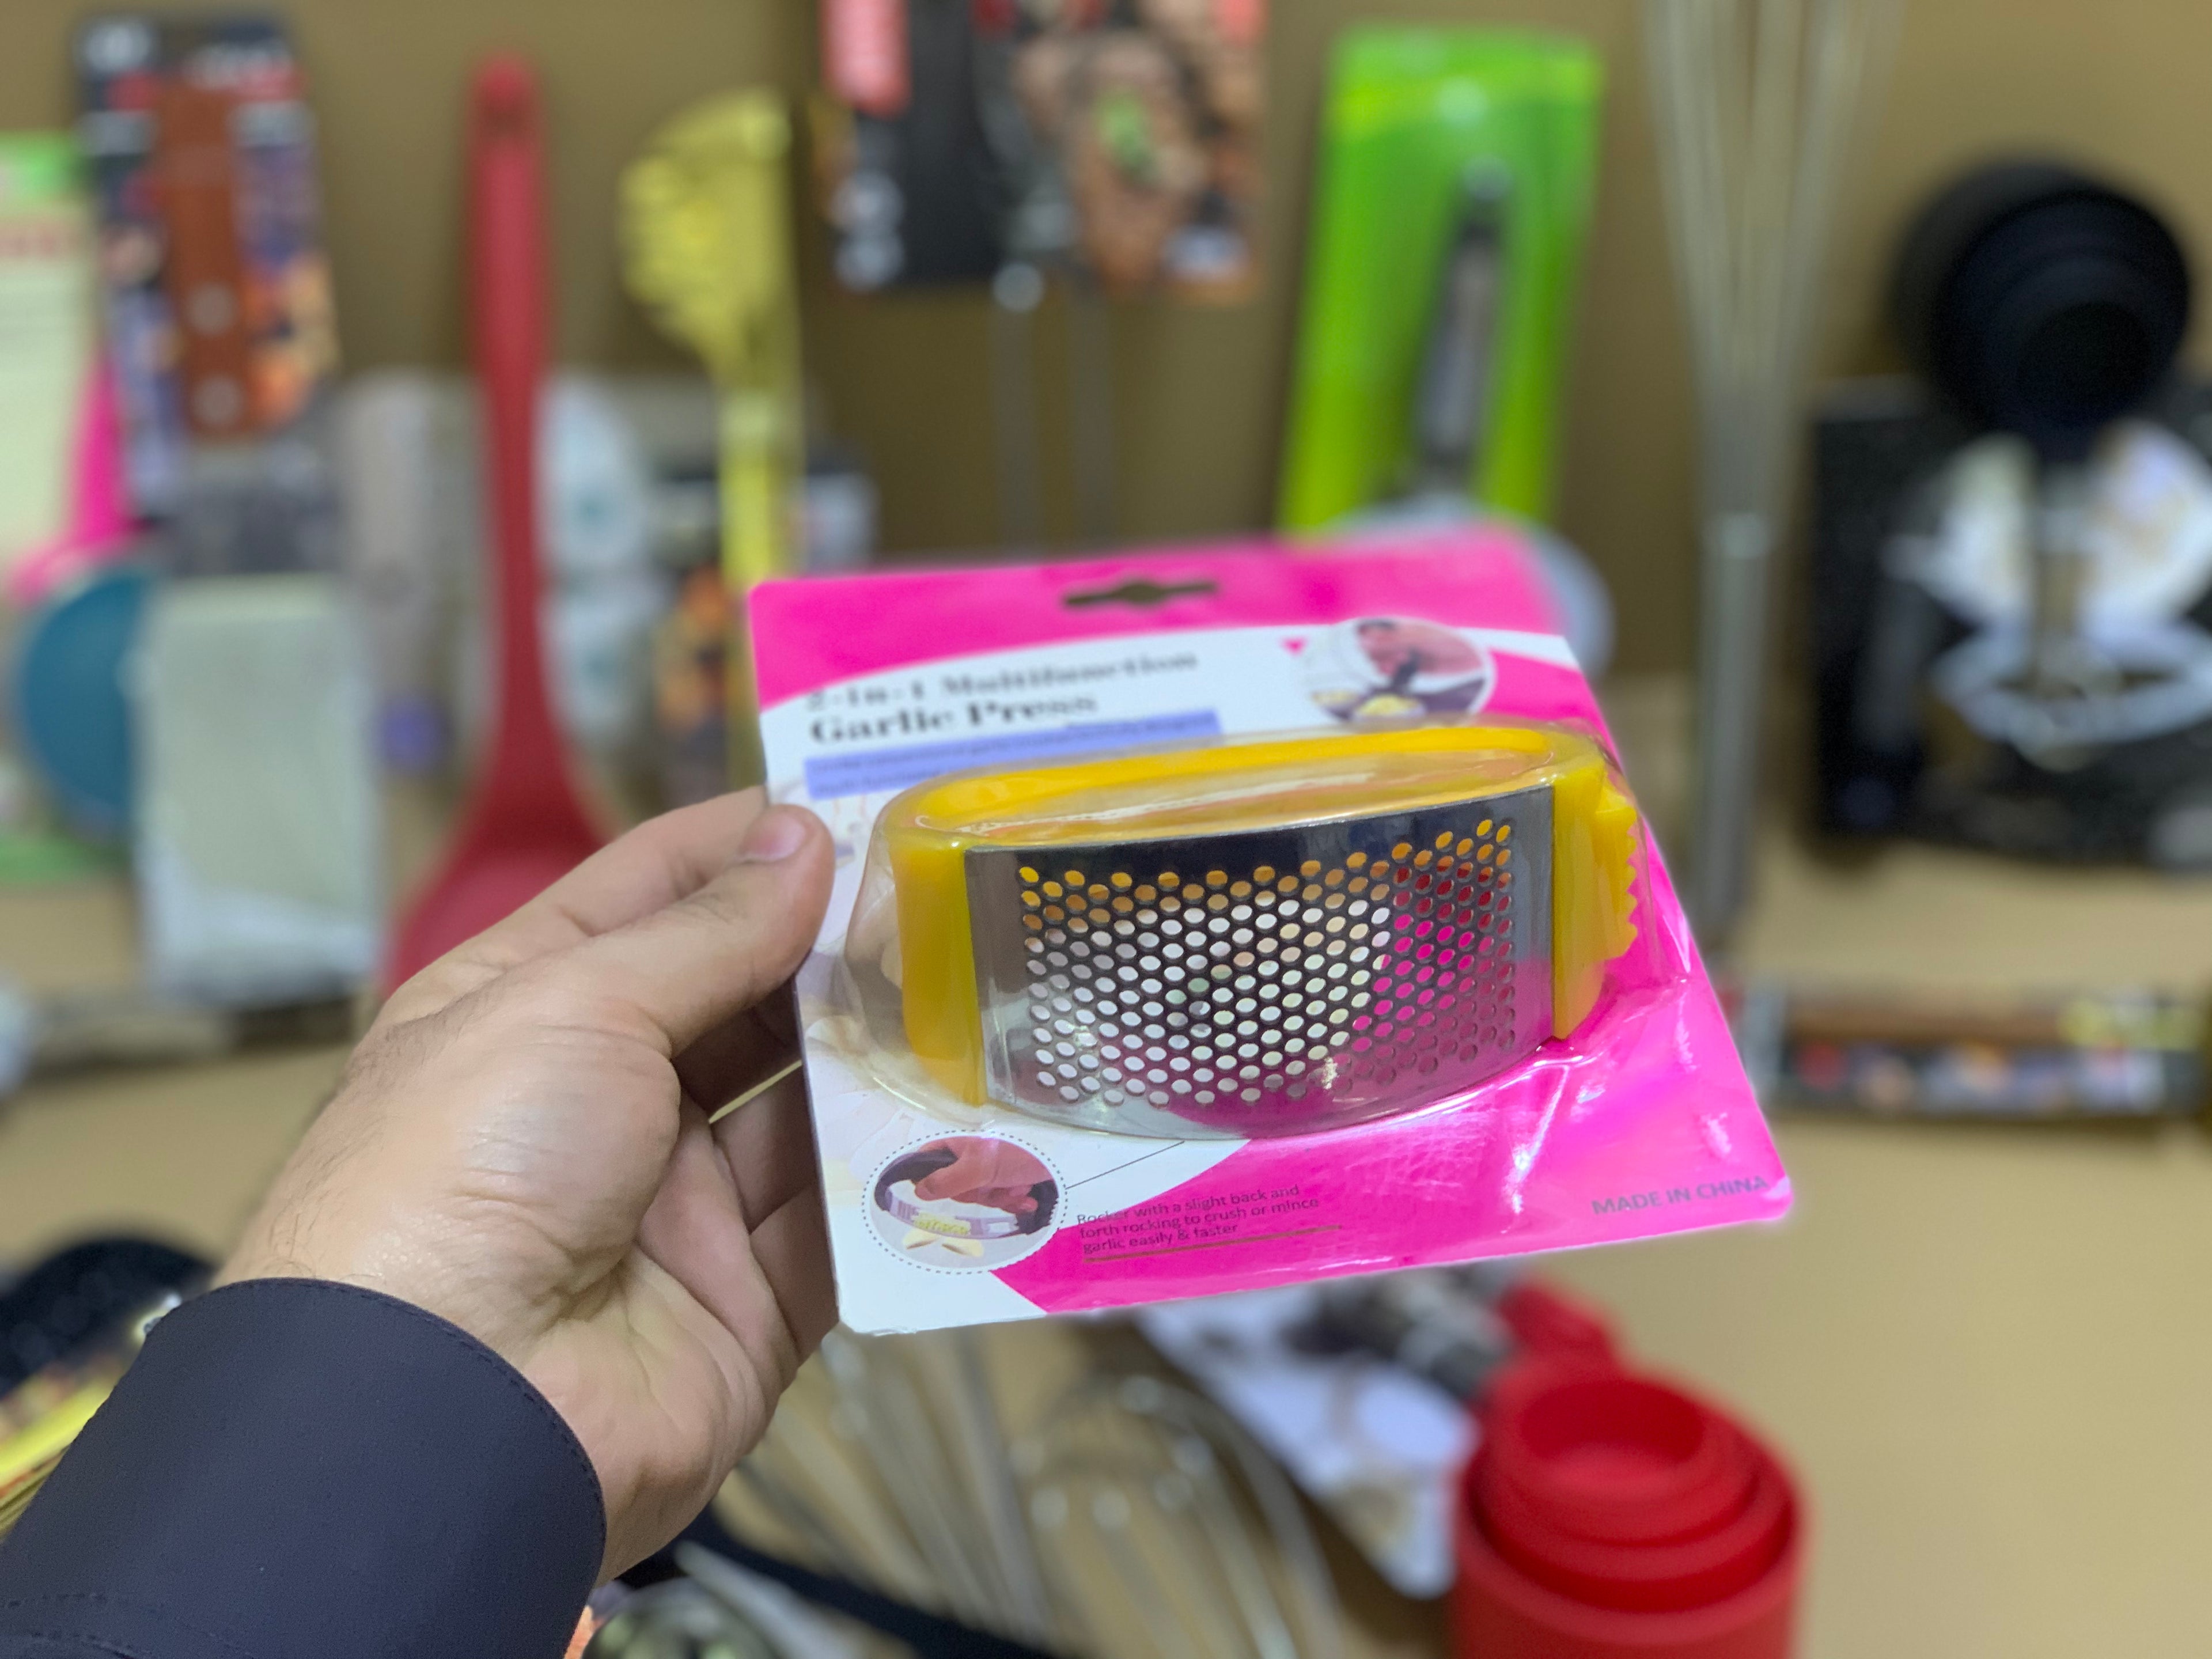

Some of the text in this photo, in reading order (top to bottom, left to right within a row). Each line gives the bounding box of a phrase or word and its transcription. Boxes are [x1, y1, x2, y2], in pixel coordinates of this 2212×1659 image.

[943, 654, 1196, 693] Multifunction
[810, 710, 953, 743] Garlic
[968, 697, 1096, 725] Press
[1077, 1184, 1299, 1224] Rocker with a slight back and
[1592, 1175, 1769, 1215] MADE IN CHINA
[1080, 1199, 1319, 1238] forth rocking to crush or mince
[1084, 1225, 1237, 1255] garlic easily & faster
